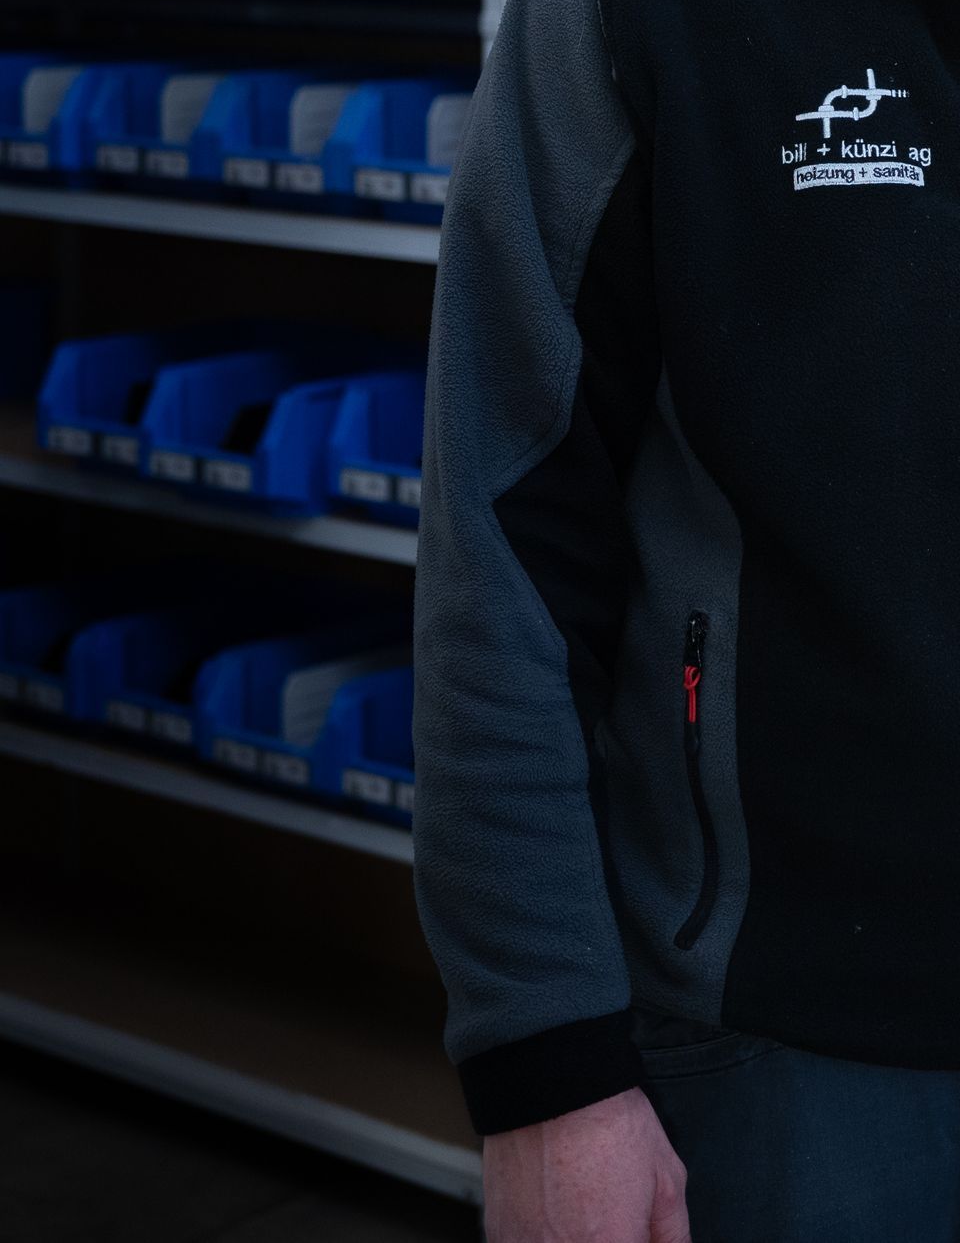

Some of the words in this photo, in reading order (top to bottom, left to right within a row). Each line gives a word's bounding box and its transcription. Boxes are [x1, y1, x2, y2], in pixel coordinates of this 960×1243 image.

[781, 142, 807, 165] bill
[816, 142, 831, 156] +
[841, 138, 897, 159] künzi
[908, 146, 932, 167] ag
[796, 166, 855, 185] heizung
[858, 167, 868, 178] +
